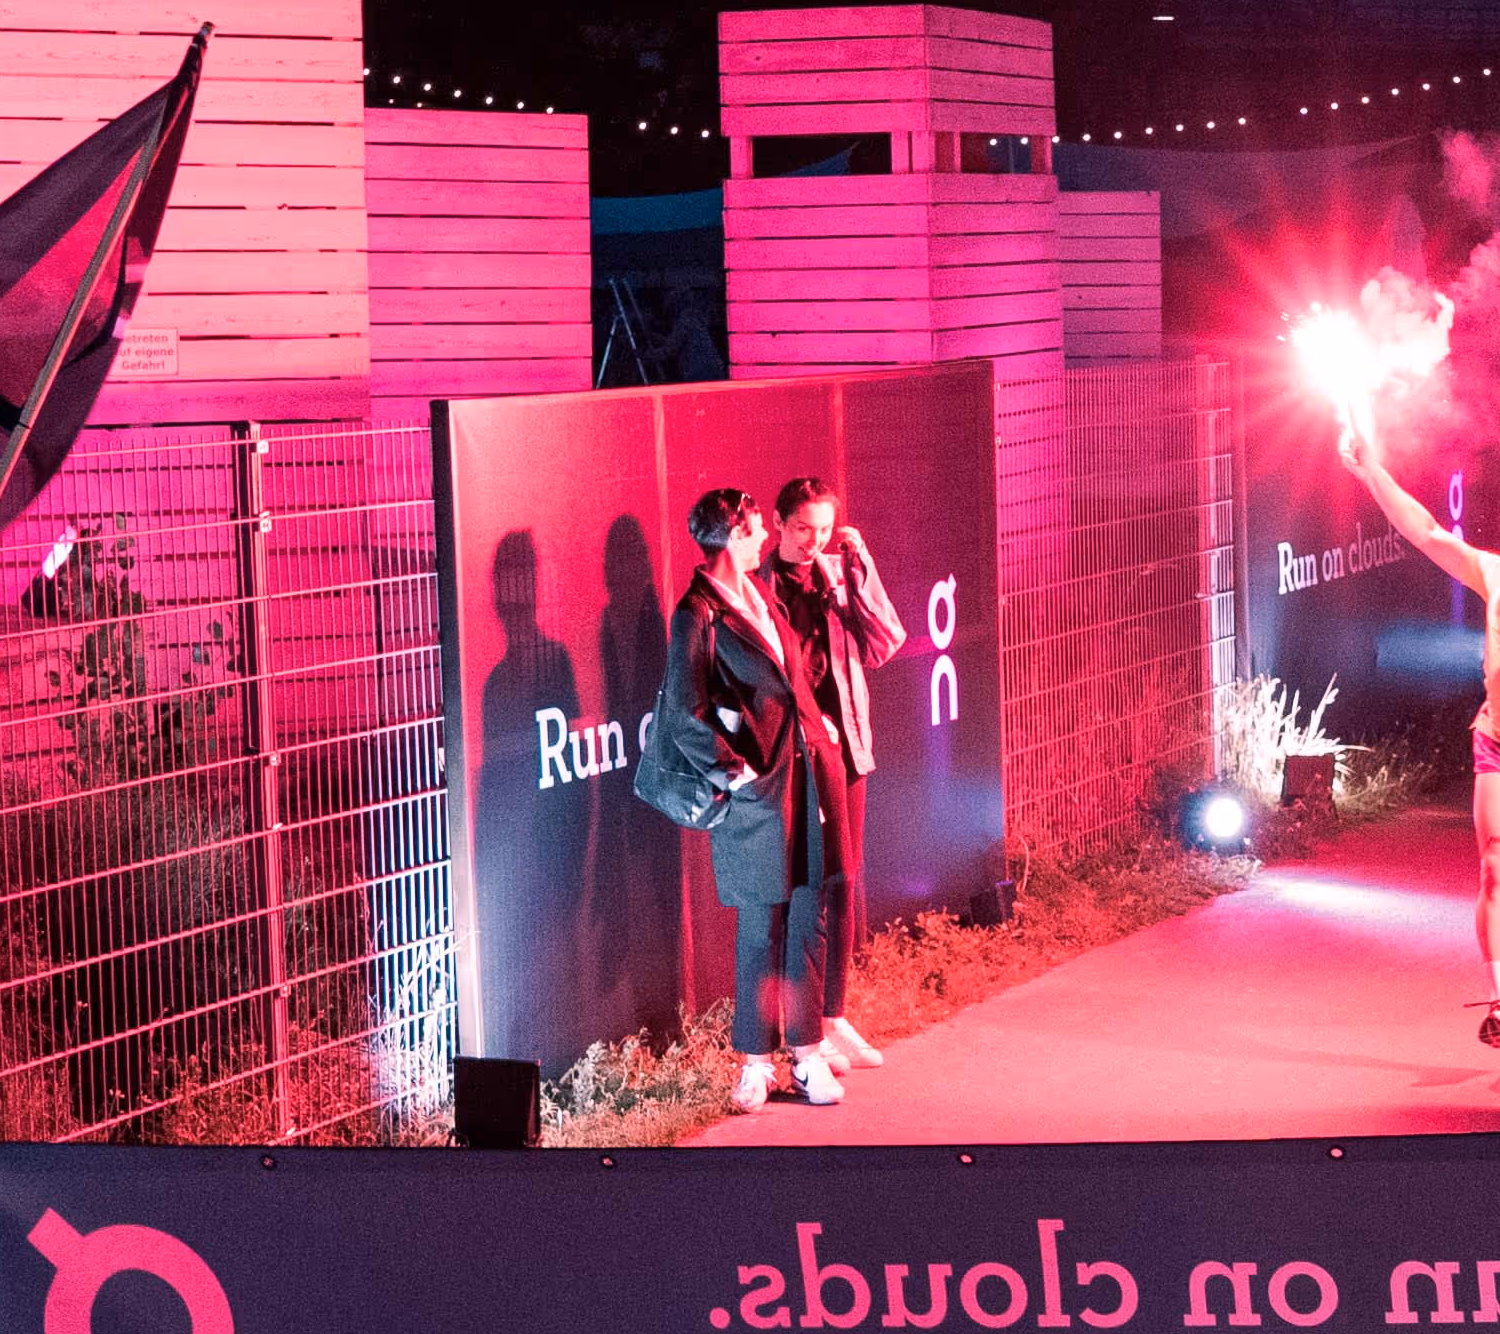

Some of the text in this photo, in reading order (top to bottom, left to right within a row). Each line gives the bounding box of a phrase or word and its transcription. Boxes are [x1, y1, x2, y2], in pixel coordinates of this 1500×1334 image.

[125, 334, 169, 344] etreten
[1277, 541, 1318, 596] Run
[1322, 546, 1345, 582] on
[535, 706, 628, 790] Run
